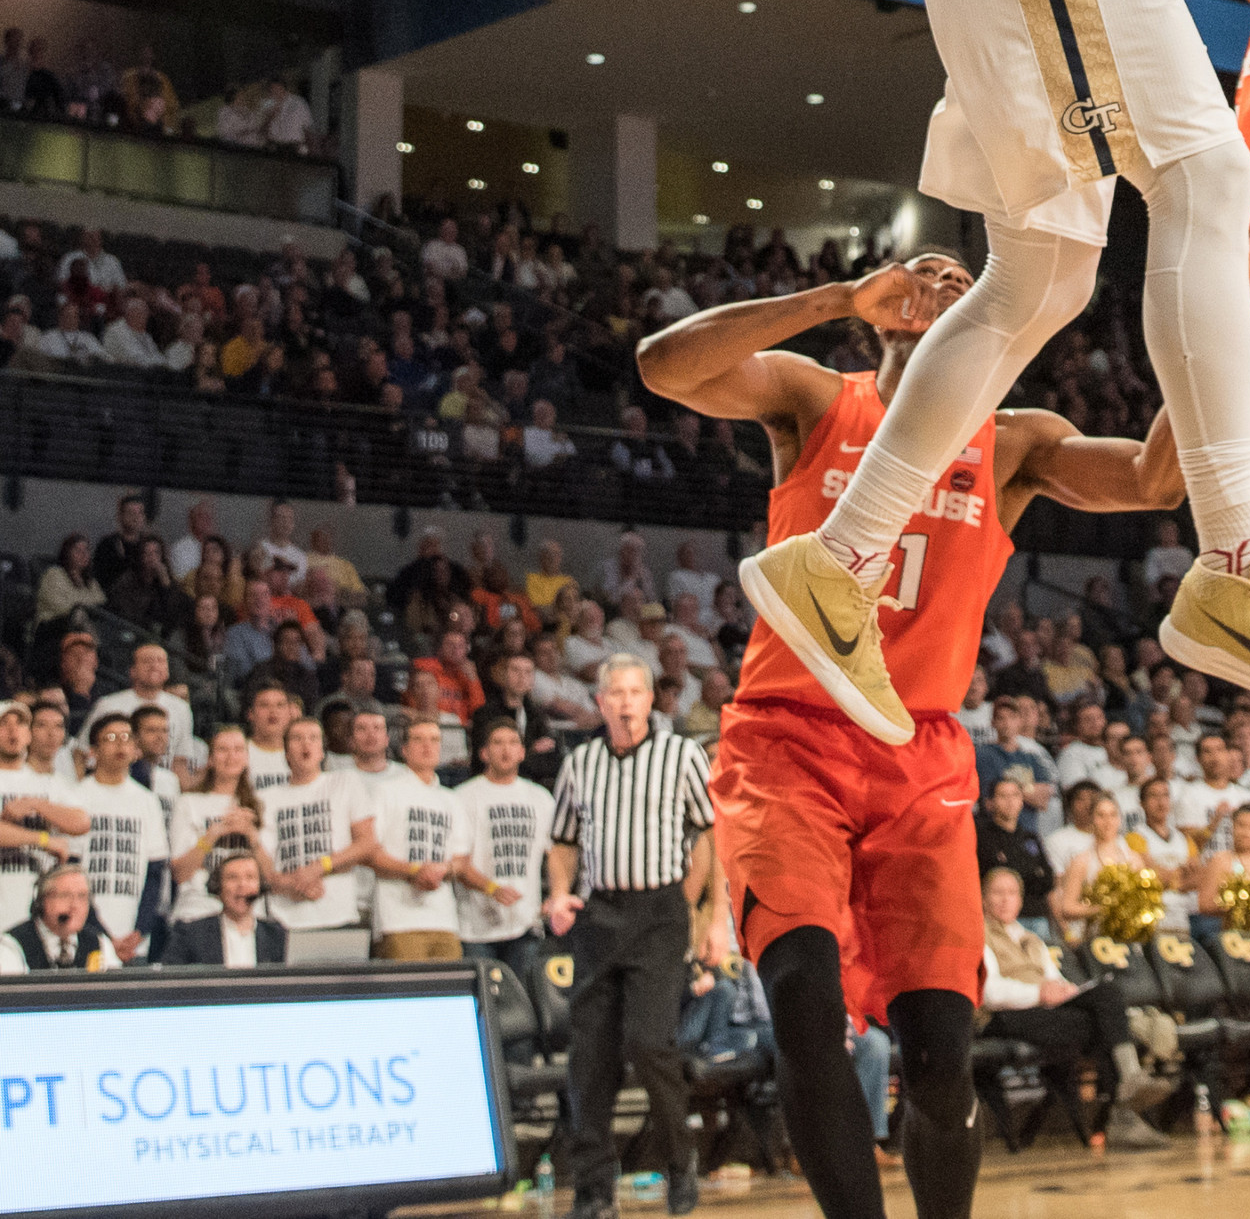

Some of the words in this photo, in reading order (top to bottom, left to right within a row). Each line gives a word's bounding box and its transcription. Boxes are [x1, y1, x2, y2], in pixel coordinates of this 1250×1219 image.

[1061, 97, 1121, 134] GT
[899, 533, 929, 610] 1
[1, 1074, 65, 1129] PT
[98, 1054, 418, 1124] SOLUTIONS
[134, 1124, 282, 1163] PHYSICAL
[290, 1118, 419, 1155] THERAPY
